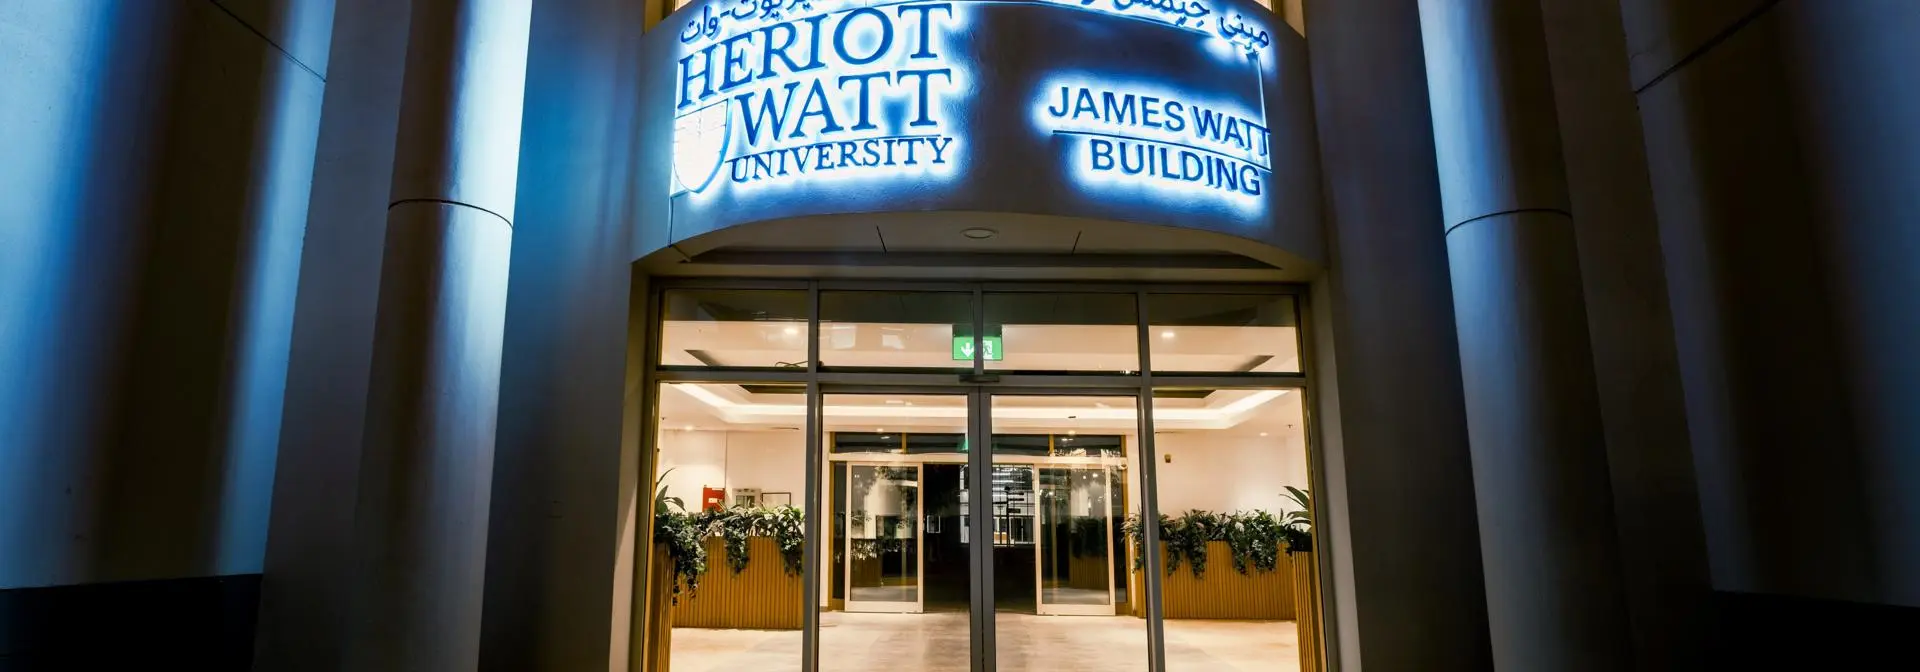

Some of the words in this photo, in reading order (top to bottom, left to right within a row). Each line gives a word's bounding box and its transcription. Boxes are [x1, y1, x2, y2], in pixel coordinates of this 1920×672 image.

[677, 3, 952, 110] HERIOT
[735, 69, 952, 147] WATT
[1049, 86, 1185, 133] JAMES
[1192, 105, 1271, 157] WATT
[730, 137, 953, 183] UNIVERSITY
[1091, 138, 1261, 196] BUILDING
